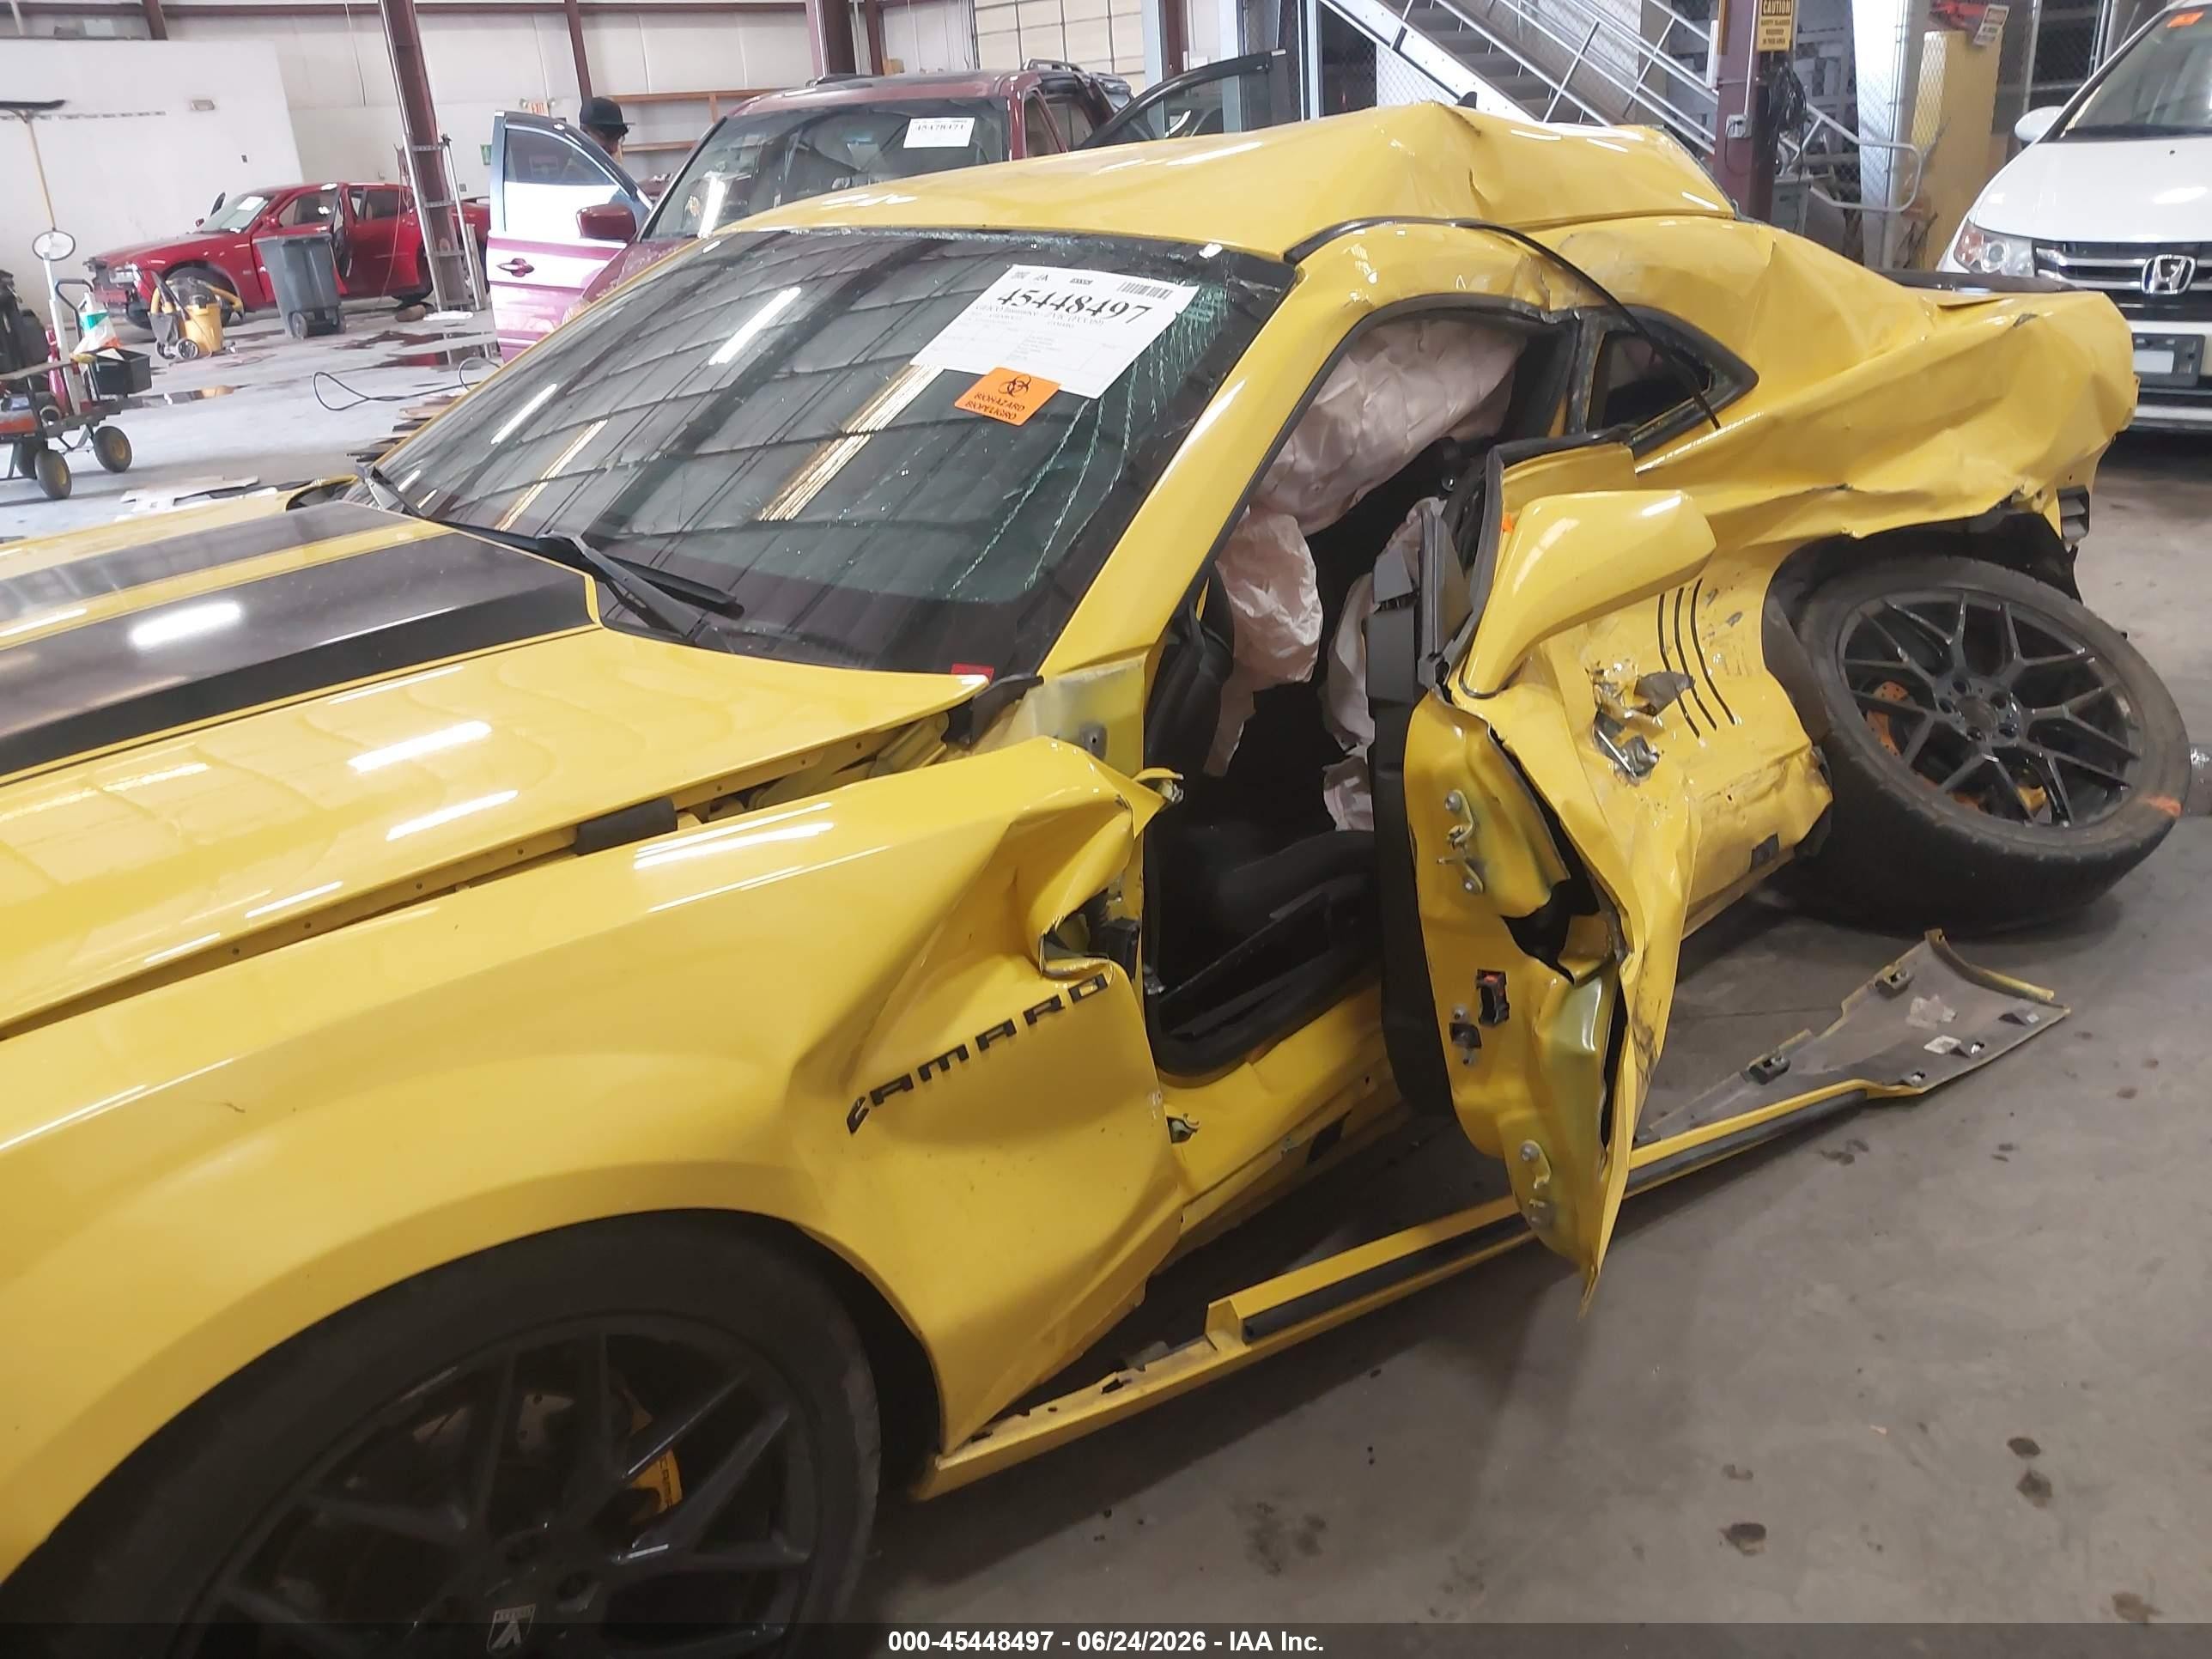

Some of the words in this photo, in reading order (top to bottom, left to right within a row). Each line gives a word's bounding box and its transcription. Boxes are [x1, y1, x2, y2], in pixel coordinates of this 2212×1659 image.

[1763, 0, 1791, 15] CAUTION
[997, 288, 1153, 324] 45448497
[974, 392, 1025, 411] BIOHAZARD
[846, 973, 1109, 1135] CAMARO
